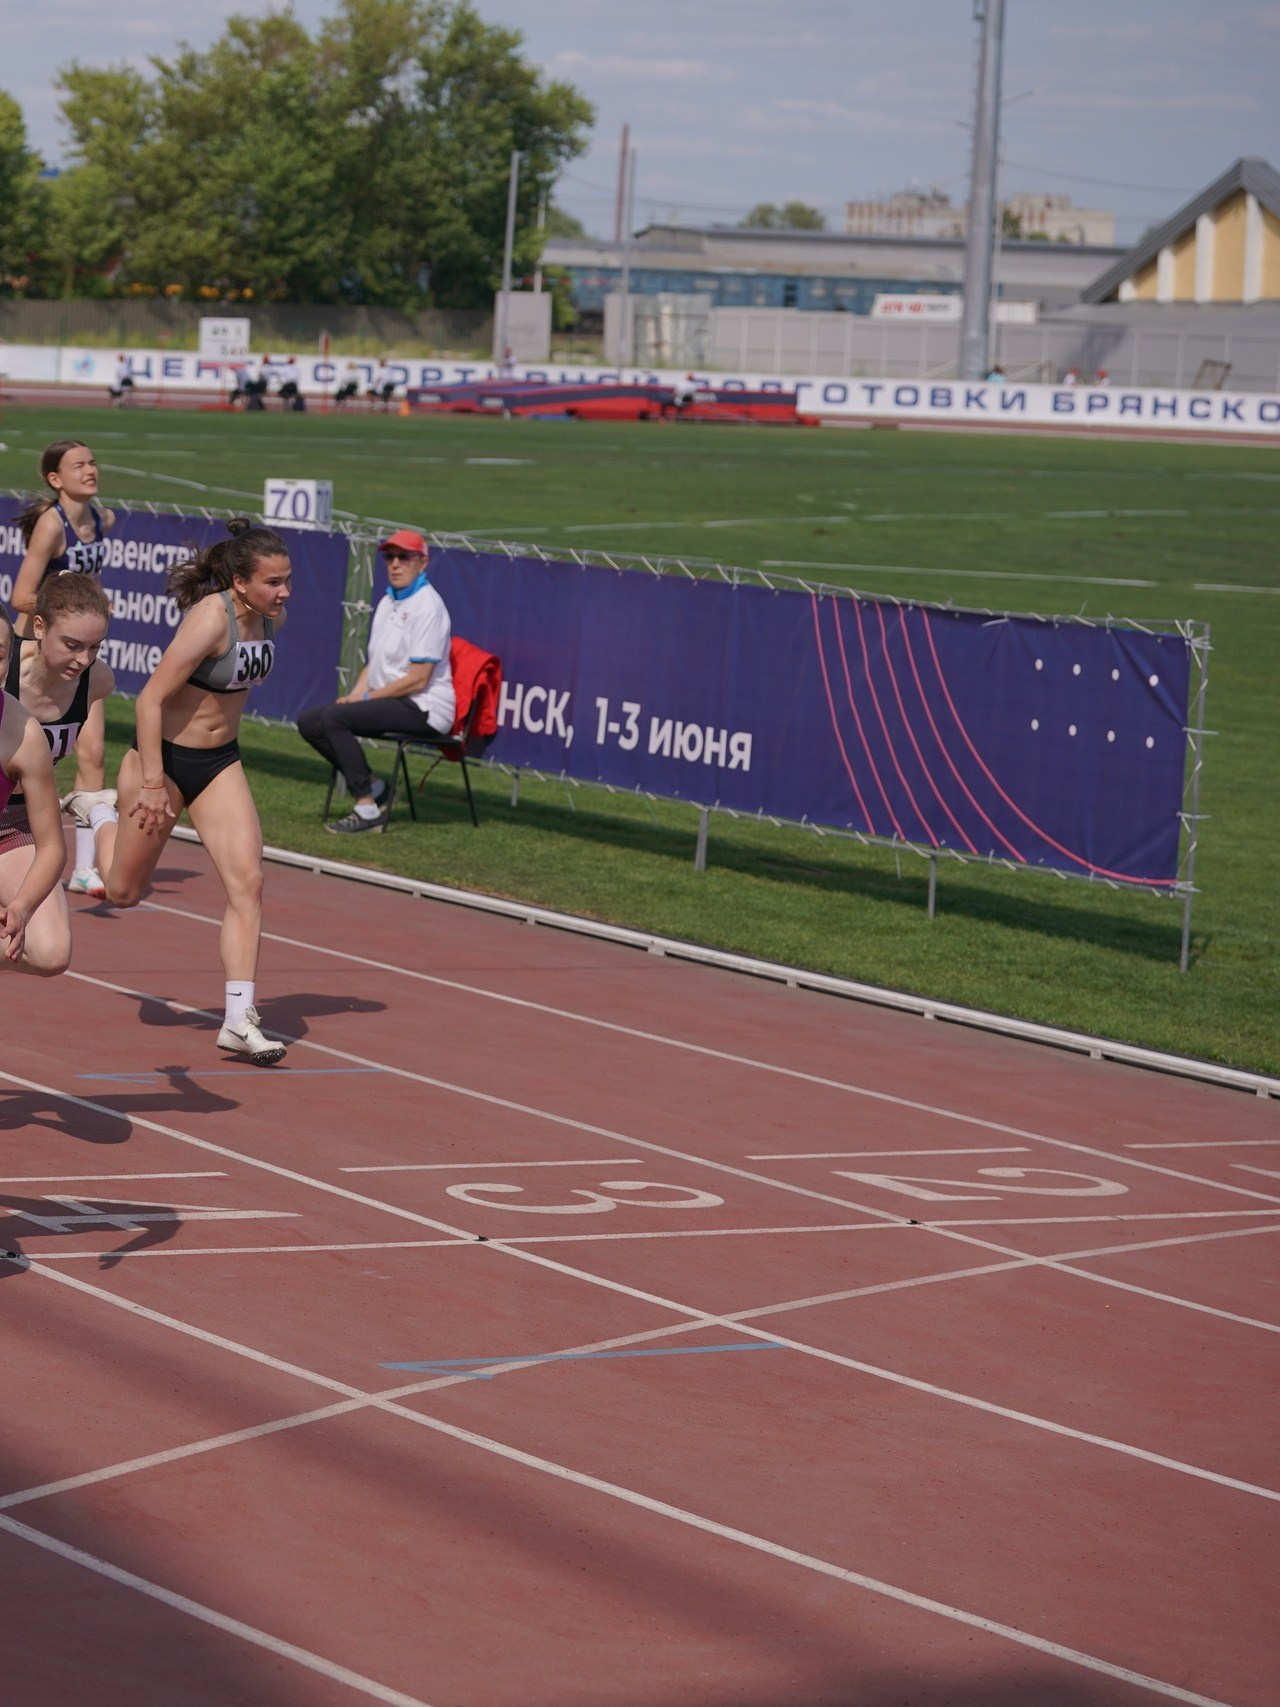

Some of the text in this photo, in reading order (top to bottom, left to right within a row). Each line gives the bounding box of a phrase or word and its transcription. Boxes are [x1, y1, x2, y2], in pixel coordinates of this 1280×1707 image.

[270, 488, 310, 520] 70
[96, 638, 163, 675] етике
[237, 644, 272, 682] 360
[497, 680, 574, 748] НСК,
[596, 697, 642, 750] 1-3
[445, 1180, 725, 1214] 3
